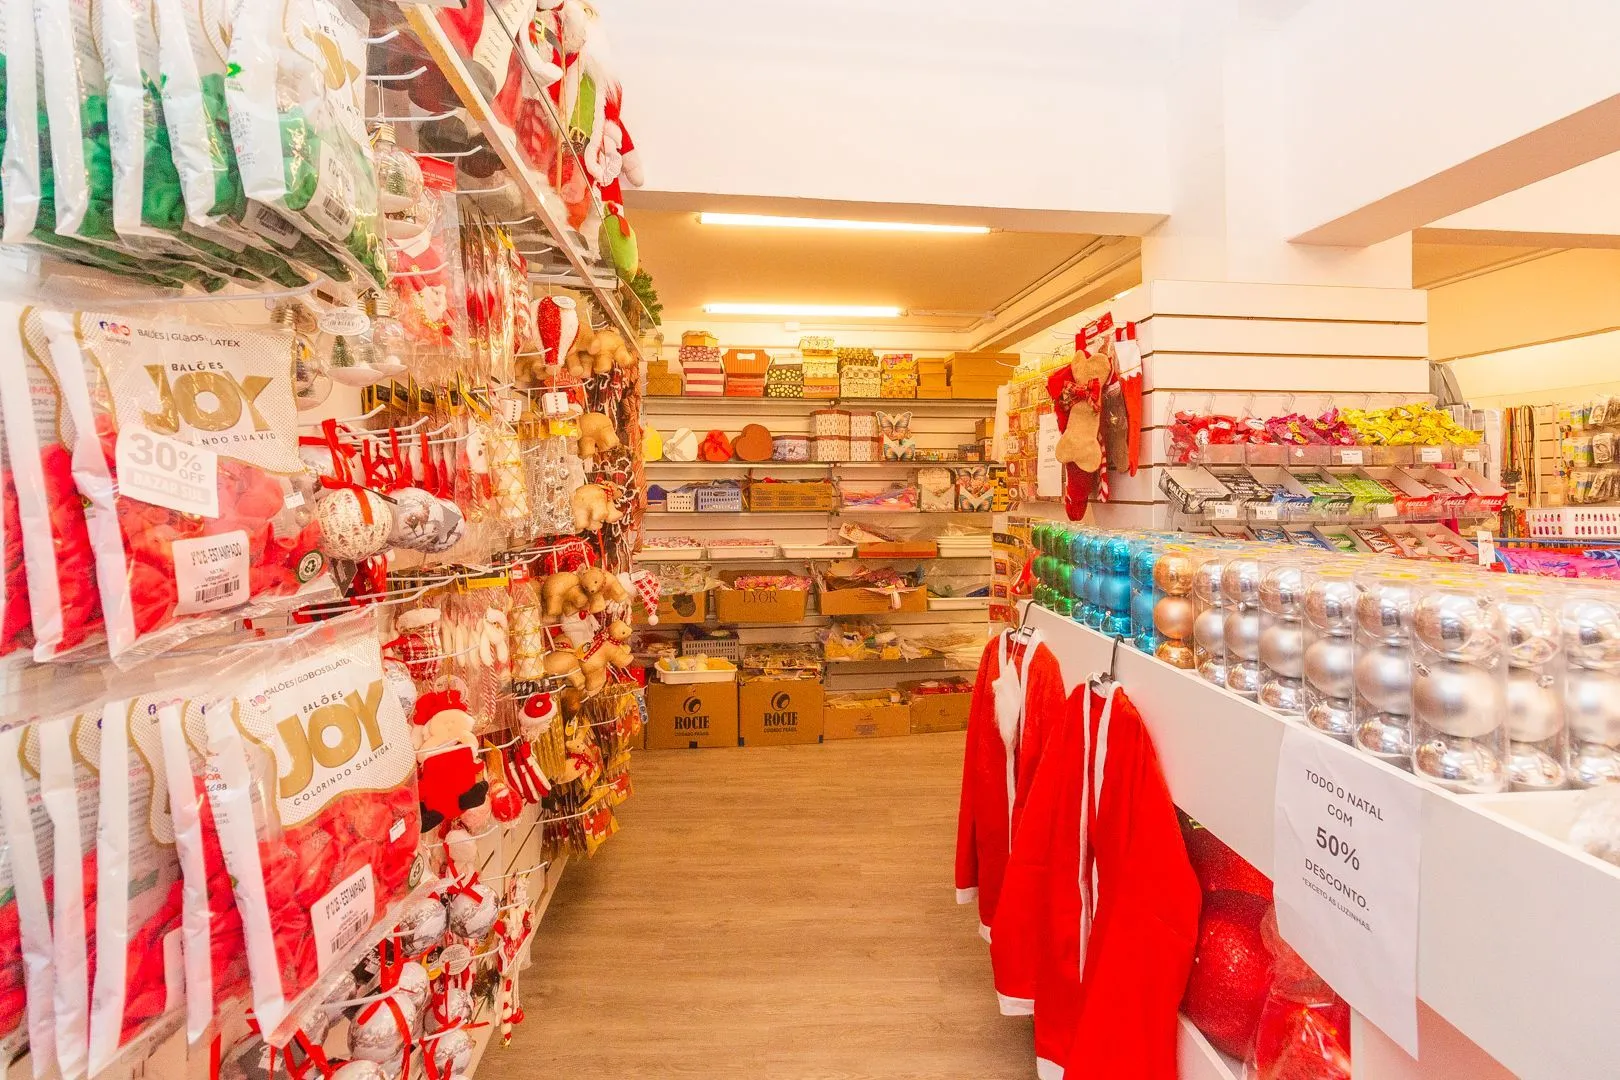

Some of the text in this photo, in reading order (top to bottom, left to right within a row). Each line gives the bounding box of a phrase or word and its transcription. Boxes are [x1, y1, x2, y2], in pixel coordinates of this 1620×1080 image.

[210, 339, 240, 347] LATEX
[142, 363, 274, 435] JOY
[127, 432, 202, 473] 30%
[179, 469, 206, 484] OFF
[1168, 481, 1187, 502] HALLS
[303, 690, 344, 713] BALÕES
[674, 715, 709, 729] ROCIE
[764, 712, 798, 726] ROCIE
[276, 678, 384, 799] JOY
[293, 768, 352, 806] COLORINDO
[1305, 769, 1384, 822] TODO O NATAL
[1327, 804, 1353, 827] COM
[1316, 826, 1360, 871] 50%
[1305, 858, 1370, 911] DESCONTO.
